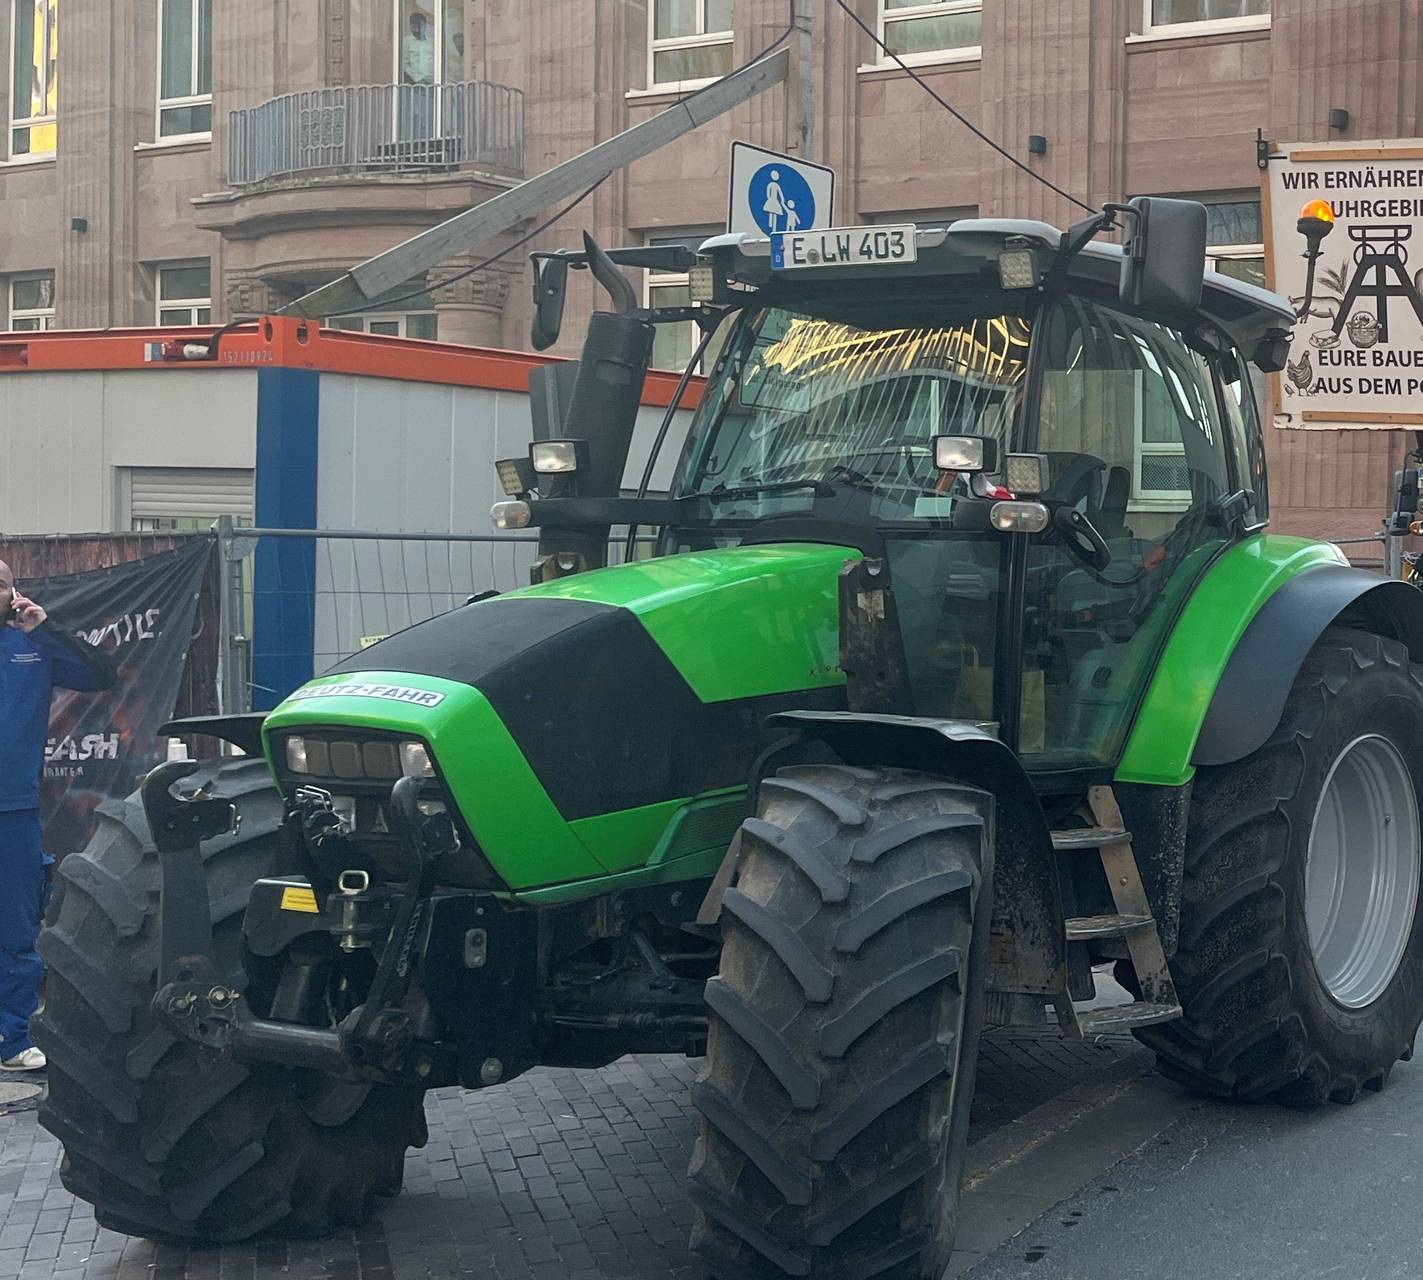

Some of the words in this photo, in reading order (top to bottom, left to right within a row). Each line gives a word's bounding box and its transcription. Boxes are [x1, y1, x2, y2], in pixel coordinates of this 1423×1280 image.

[1282, 172, 1320, 190] WIR
[792, 237, 807, 264] E
[821, 233, 851, 263] LW
[859, 230, 905, 260] 403
[1318, 350, 1367, 367] EURE
[1315, 377, 1353, 394] AUS
[1358, 379, 1402, 395] DEM
